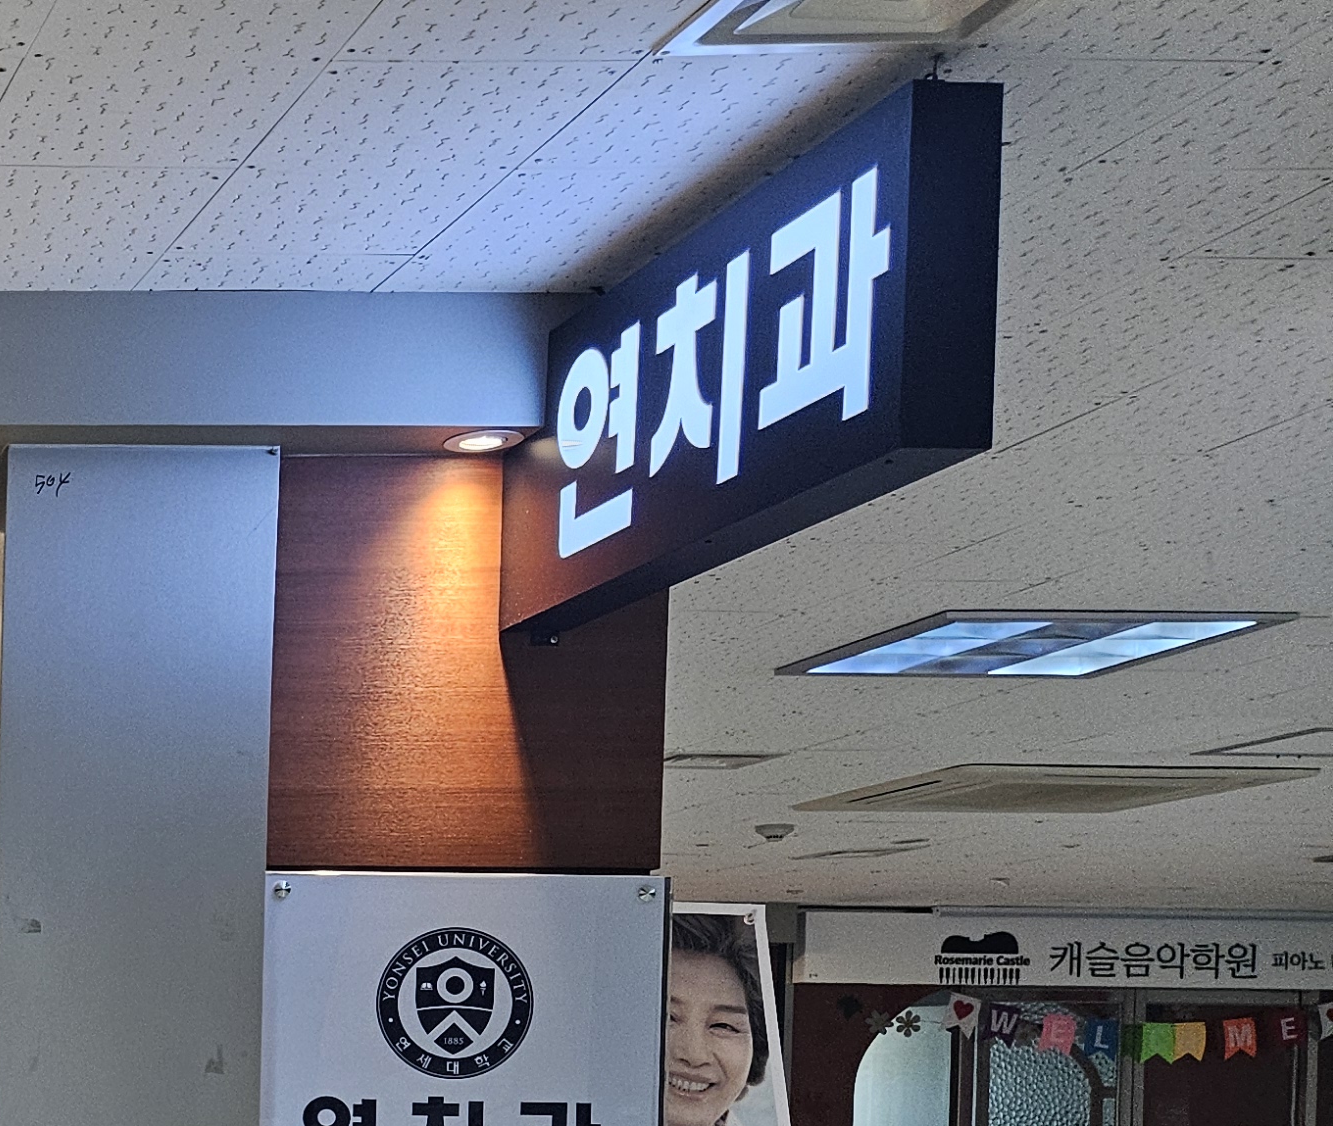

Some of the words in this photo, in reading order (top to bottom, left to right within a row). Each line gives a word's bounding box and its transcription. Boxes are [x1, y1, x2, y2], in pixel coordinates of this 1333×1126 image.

[557, 165, 890, 558] 연치과
[383, 940, 429, 1002] YONSEI
[437, 934, 528, 1004] UNIVERSITY
[934, 954, 993, 966] Rosemarie
[996, 955, 1030, 967] Castle
[1050, 941, 1258, 979] 캐슬음악학원
[1271, 951, 1326, 971] 피아노
[395, 1036, 514, 1075] 연세대학교
[443, 1037, 464, 1045] 1885
